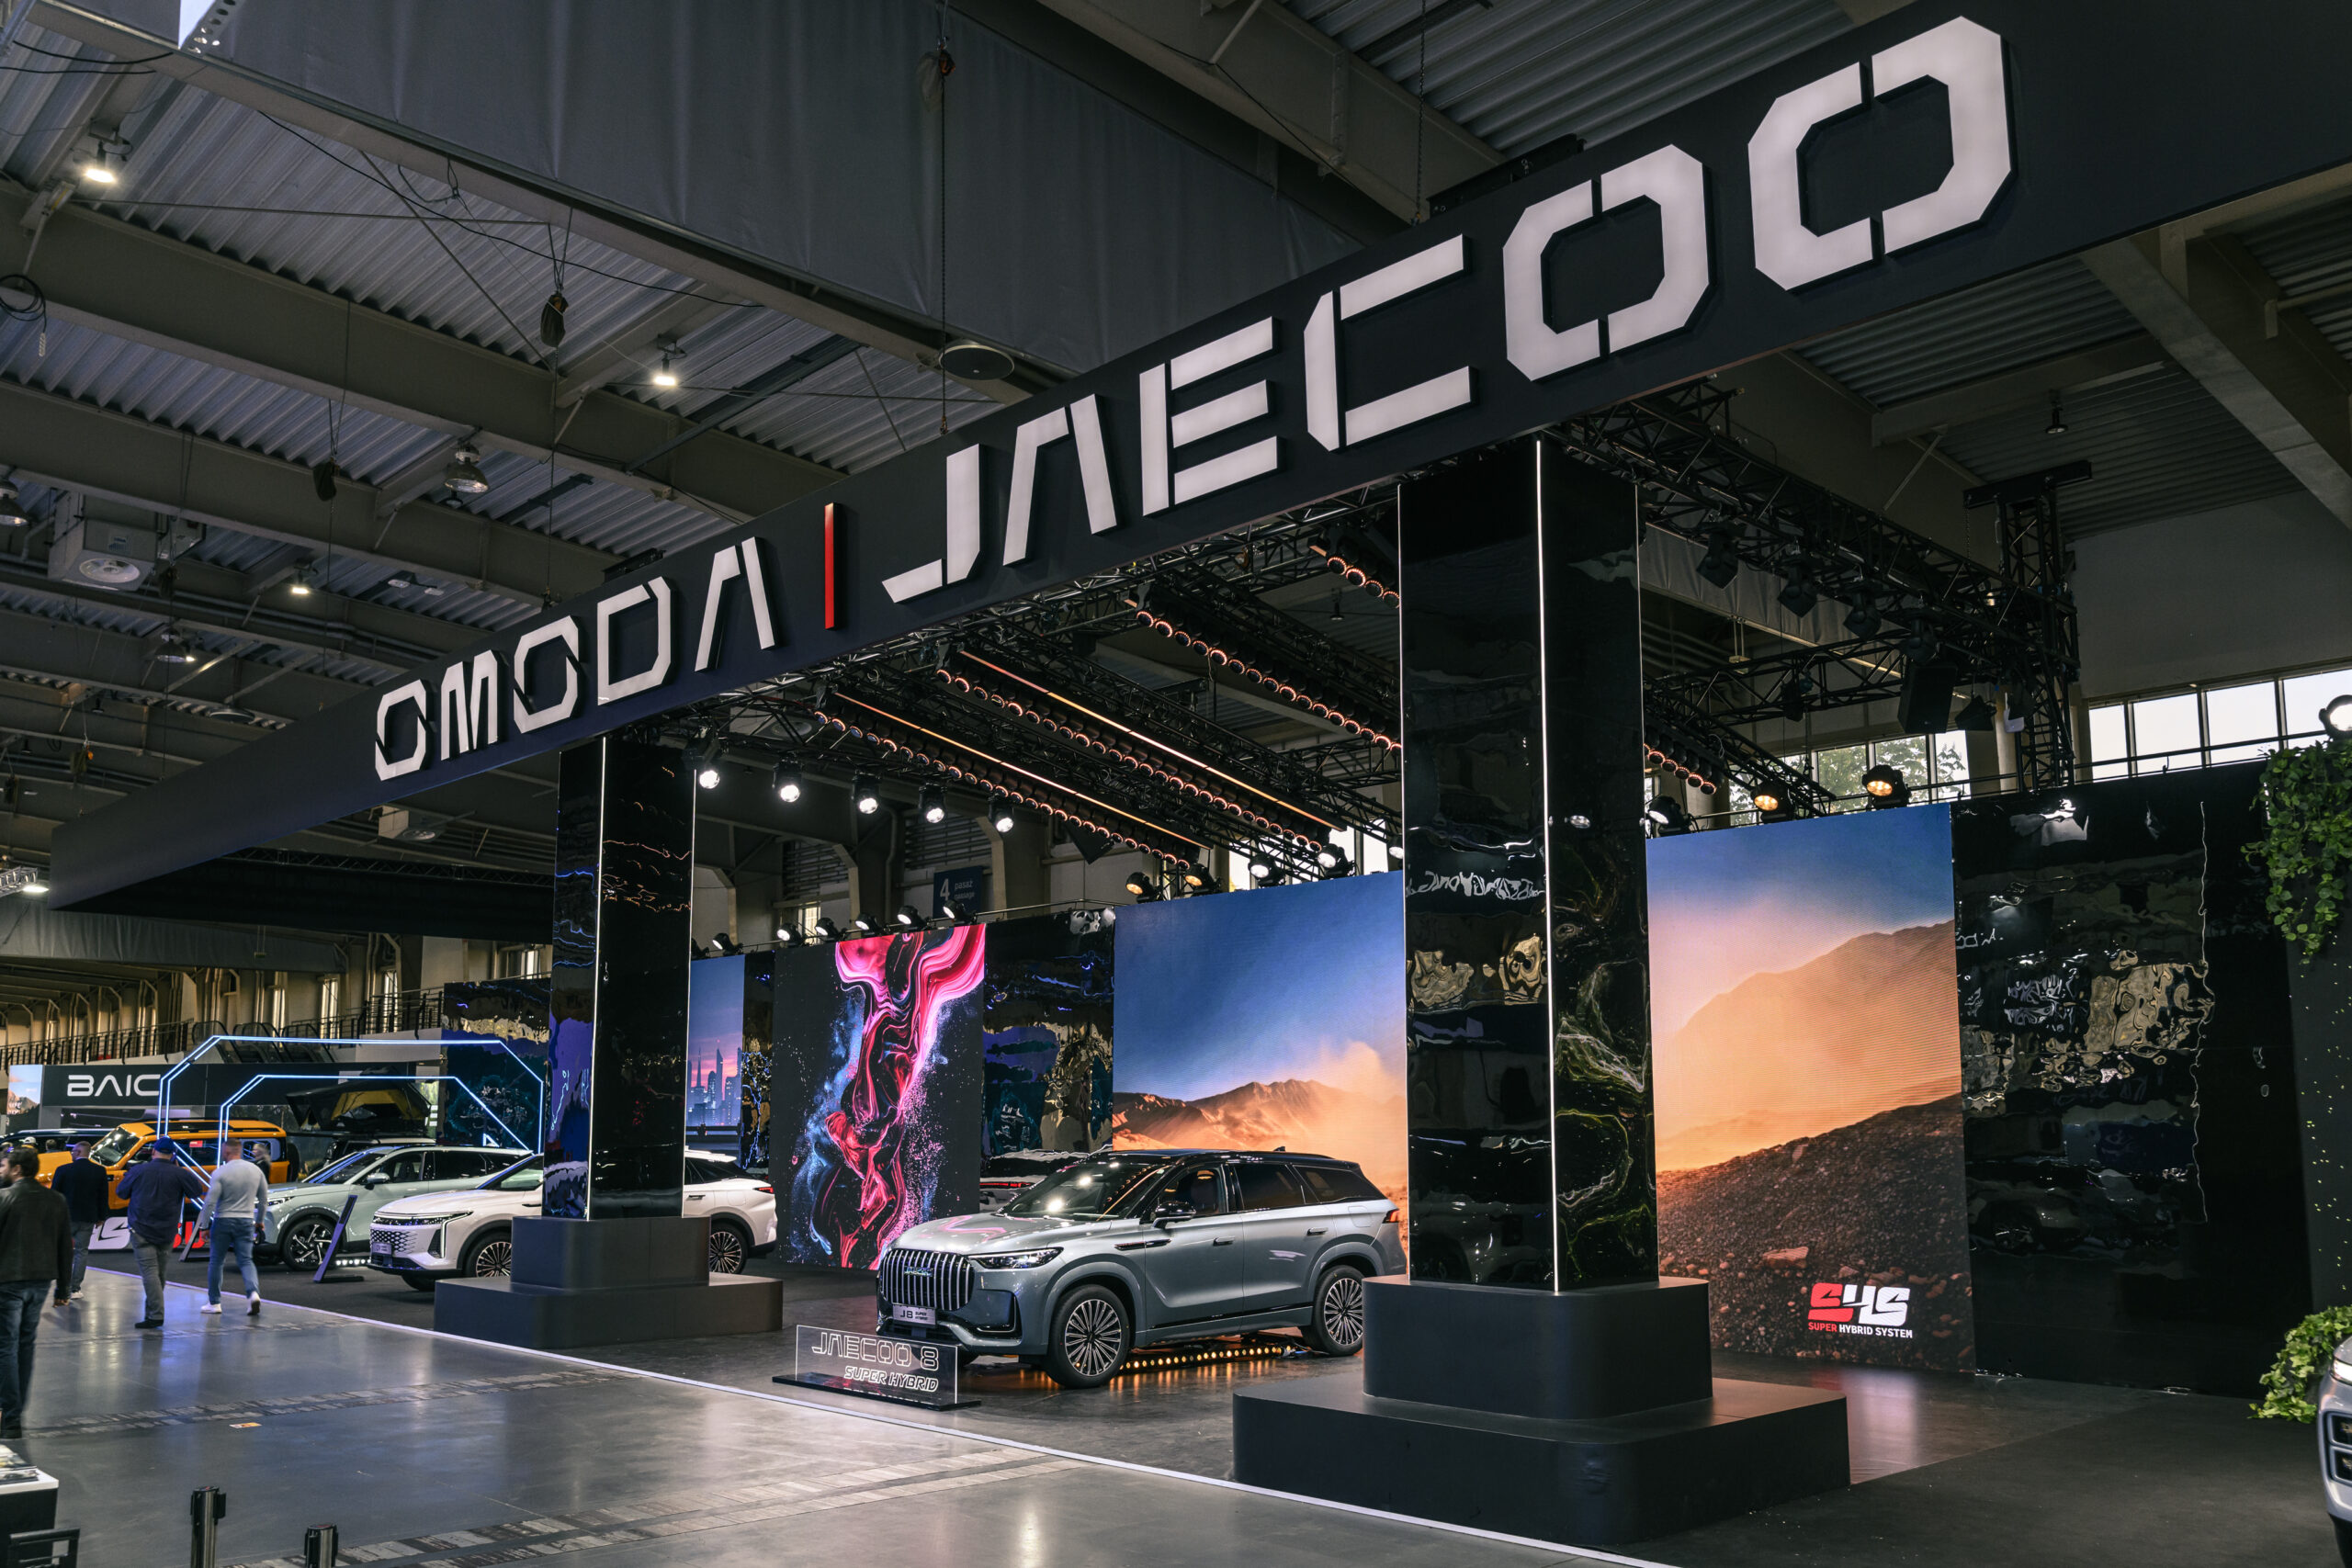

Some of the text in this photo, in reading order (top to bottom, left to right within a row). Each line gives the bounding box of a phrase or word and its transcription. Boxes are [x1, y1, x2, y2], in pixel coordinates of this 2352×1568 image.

[882, 16, 2012, 603] JAECOO
[375, 536, 775, 781] OMODA
[940, 878, 950, 901] 4
[67, 1074, 161, 1097] BAIC
[1808, 1322, 1913, 1338] SUPER HYBRID SYSTEM
[811, 1332, 939, 1371] JAECOO 8
[843, 1365, 939, 1393] SUPER HYBRID
